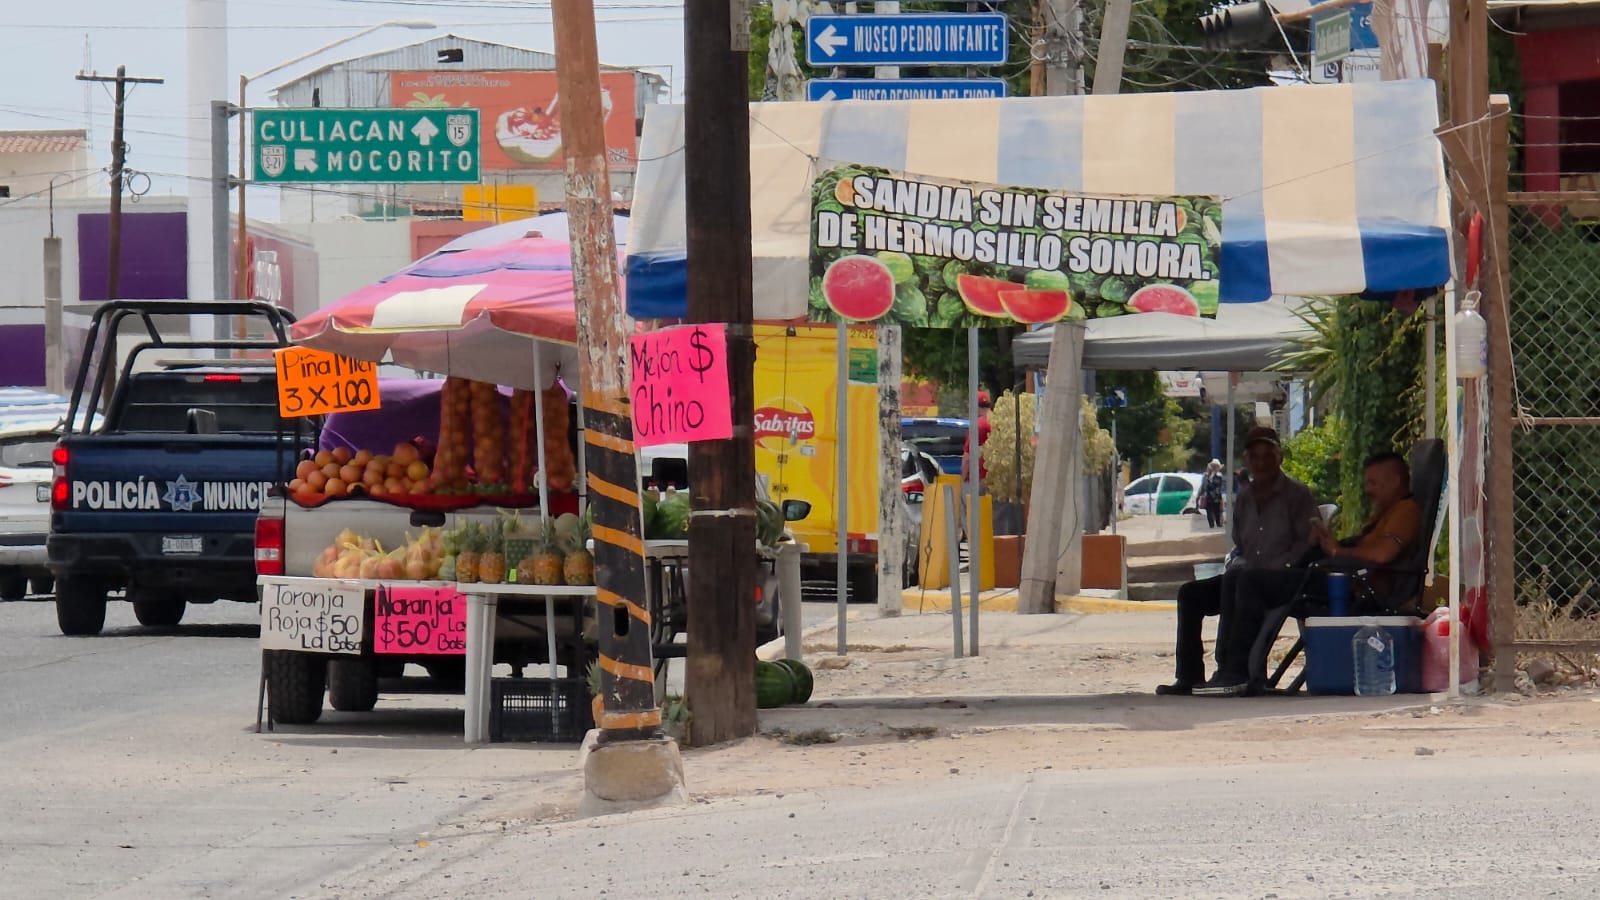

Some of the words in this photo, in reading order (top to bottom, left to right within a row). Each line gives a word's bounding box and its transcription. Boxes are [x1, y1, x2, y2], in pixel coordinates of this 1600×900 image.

[854, 25, 897, 53] MUSEO
[900, 25, 941, 53] PEDRO
[945, 24, 999, 52] INFANTE
[260, 120, 405, 142] CULIACAN
[453, 126, 465, 140] 15
[327, 150, 472, 172] MOCORITO
[852, 175, 973, 223] SANDIA
[979, 190, 1037, 229] SIN
[1042, 196, 1179, 238] SEMILLA
[817, 210, 859, 249] DE
[864, 214, 1063, 271] HERMOSILLO
[1067, 236, 1212, 281] SONORA.
[282, 349, 331, 381] Piña
[630, 338, 683, 382] Melón
[688, 326, 714, 384] $
[285, 387, 304, 412] 3
[332, 378, 372, 409] 100
[634, 383, 705, 437] Chino
[754, 413, 815, 433] Sabritas
[72, 475, 161, 510] POLICÍA
[269, 584, 344, 616] Toronja
[377, 583, 453, 629] Naranja
[269, 606, 312, 640] Roja
[380, 615, 432, 651] $50
[301, 633, 324, 650] La
